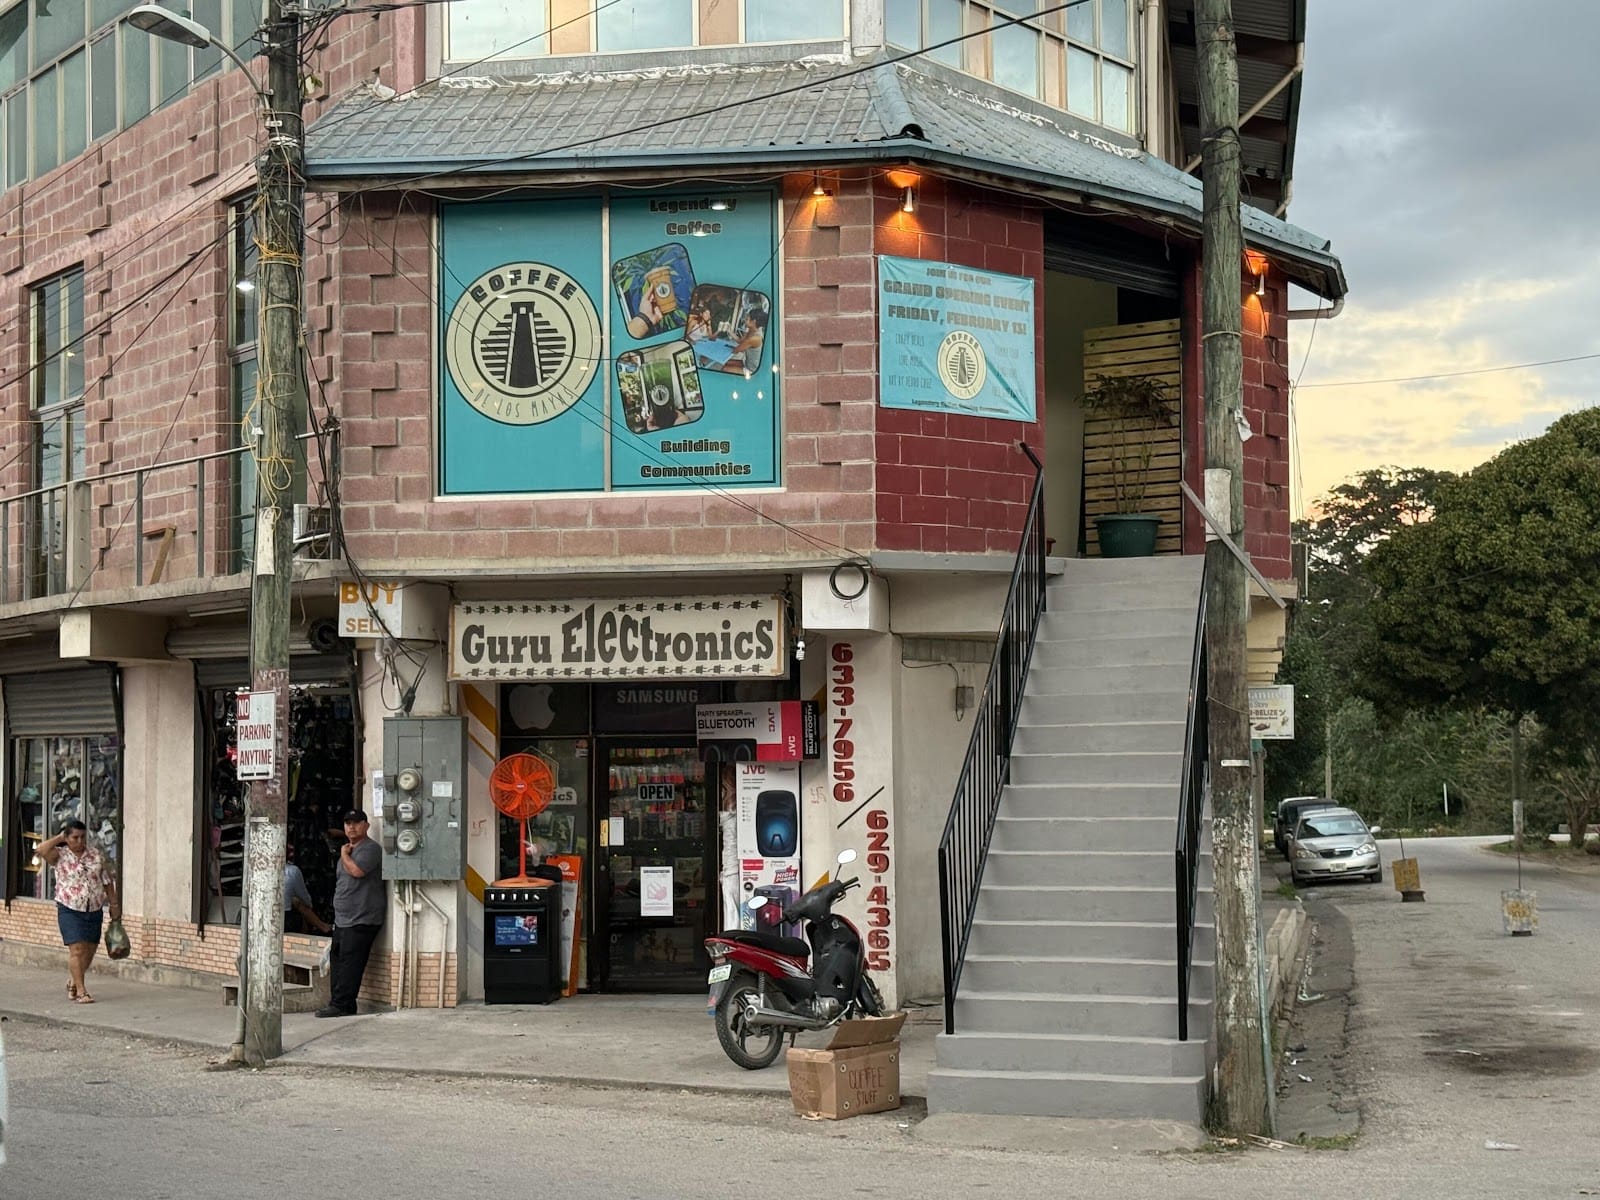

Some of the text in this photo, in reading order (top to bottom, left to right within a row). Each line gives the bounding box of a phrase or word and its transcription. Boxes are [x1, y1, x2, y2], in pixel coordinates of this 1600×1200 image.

[666, 221, 721, 236] Coffee
[470, 269, 577, 301] COFFEE
[884, 280, 933, 298] GRAND
[993, 295, 1030, 313] EVENT
[946, 311, 1009, 333] FEBRUARY
[474, 387, 574, 418] DE LOS MAYAS
[660, 439, 730, 454] Building
[640, 462, 752, 478] Communities
[341, 582, 399, 605] BUY
[461, 624, 552, 664] Guru
[616, 688, 699, 704] SAMSUNG
[238, 698, 250, 717] NO
[697, 718, 755, 729] BLUETOOTH
[767, 707, 776, 733] JVC
[831, 642, 855, 803] 633-7956
[239, 723, 272, 741] PARKING
[788, 735, 796, 757] JVC
[239, 749, 273, 766] ANYTIME
[742, 764, 766, 775] JVC
[640, 785, 673, 800] OPEN
